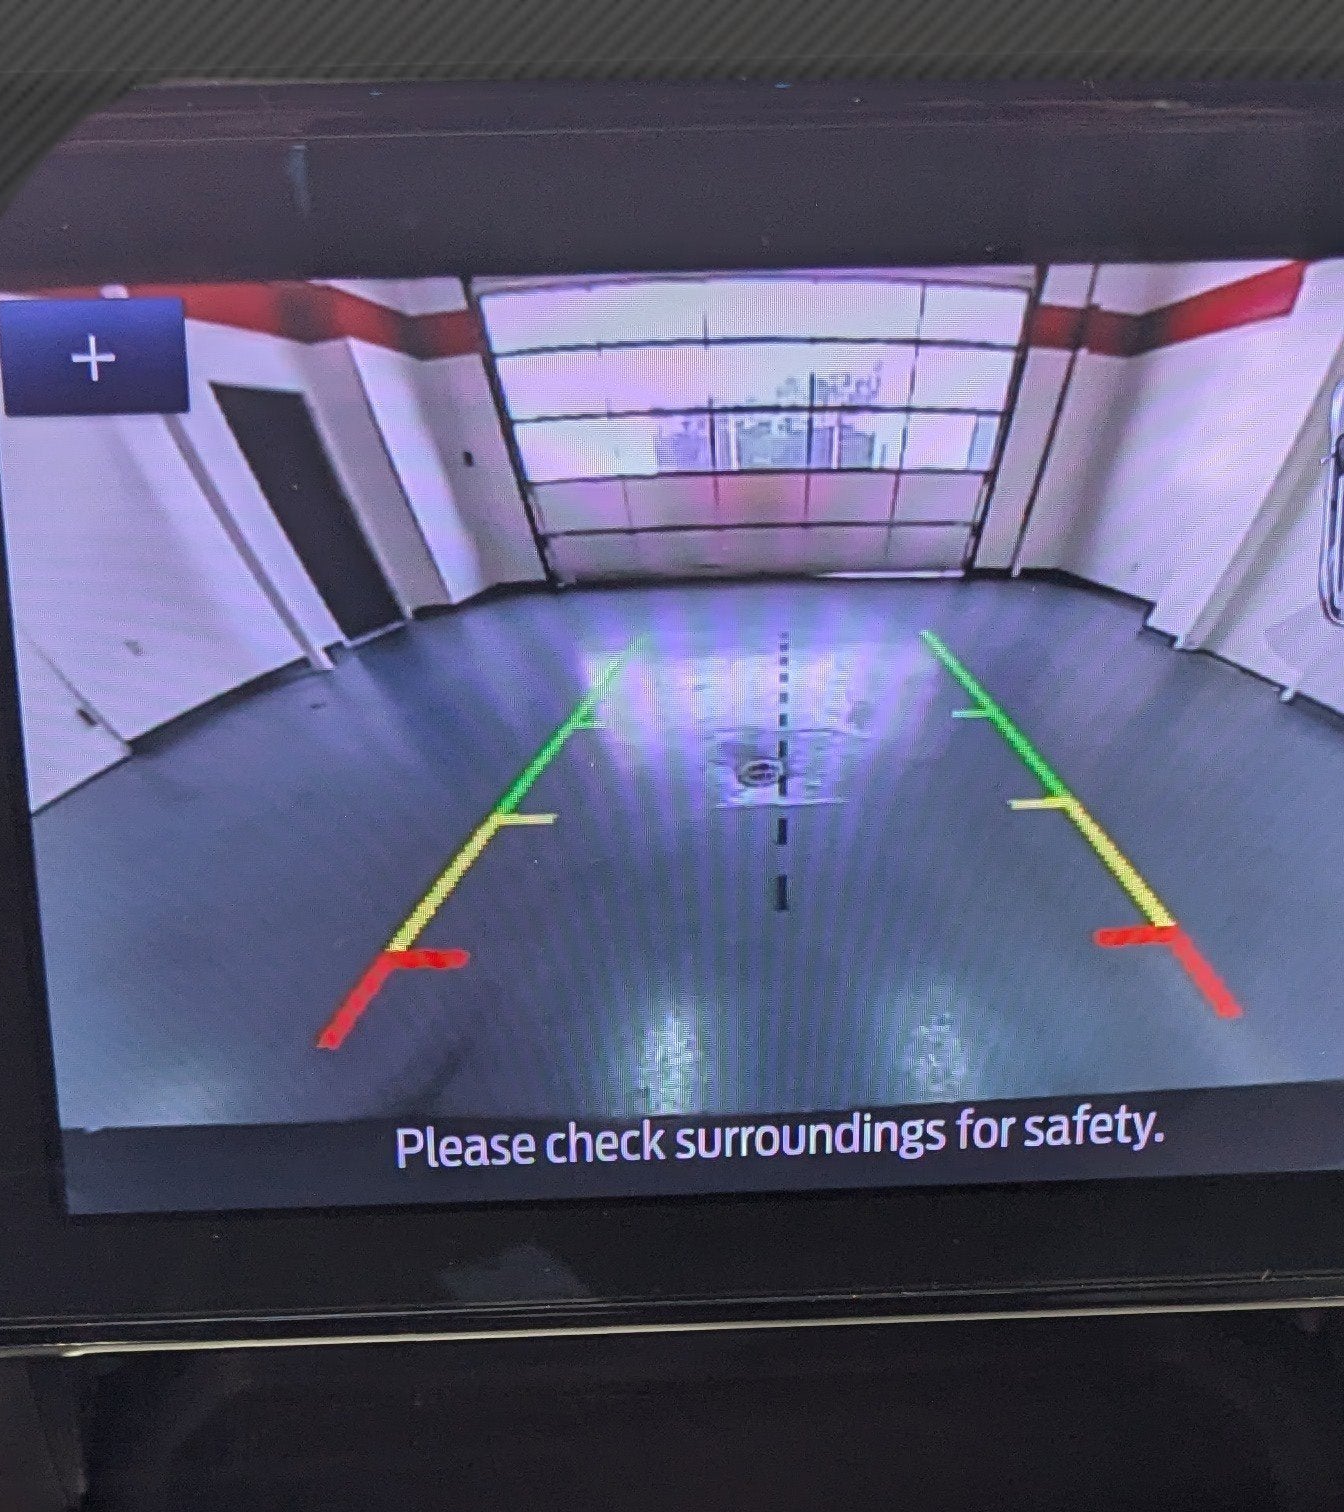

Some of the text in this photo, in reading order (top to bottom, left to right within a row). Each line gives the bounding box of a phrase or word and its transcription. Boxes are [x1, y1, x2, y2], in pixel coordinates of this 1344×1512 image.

[396, 1103, 1166, 1169] Please check surroundings for safety.
